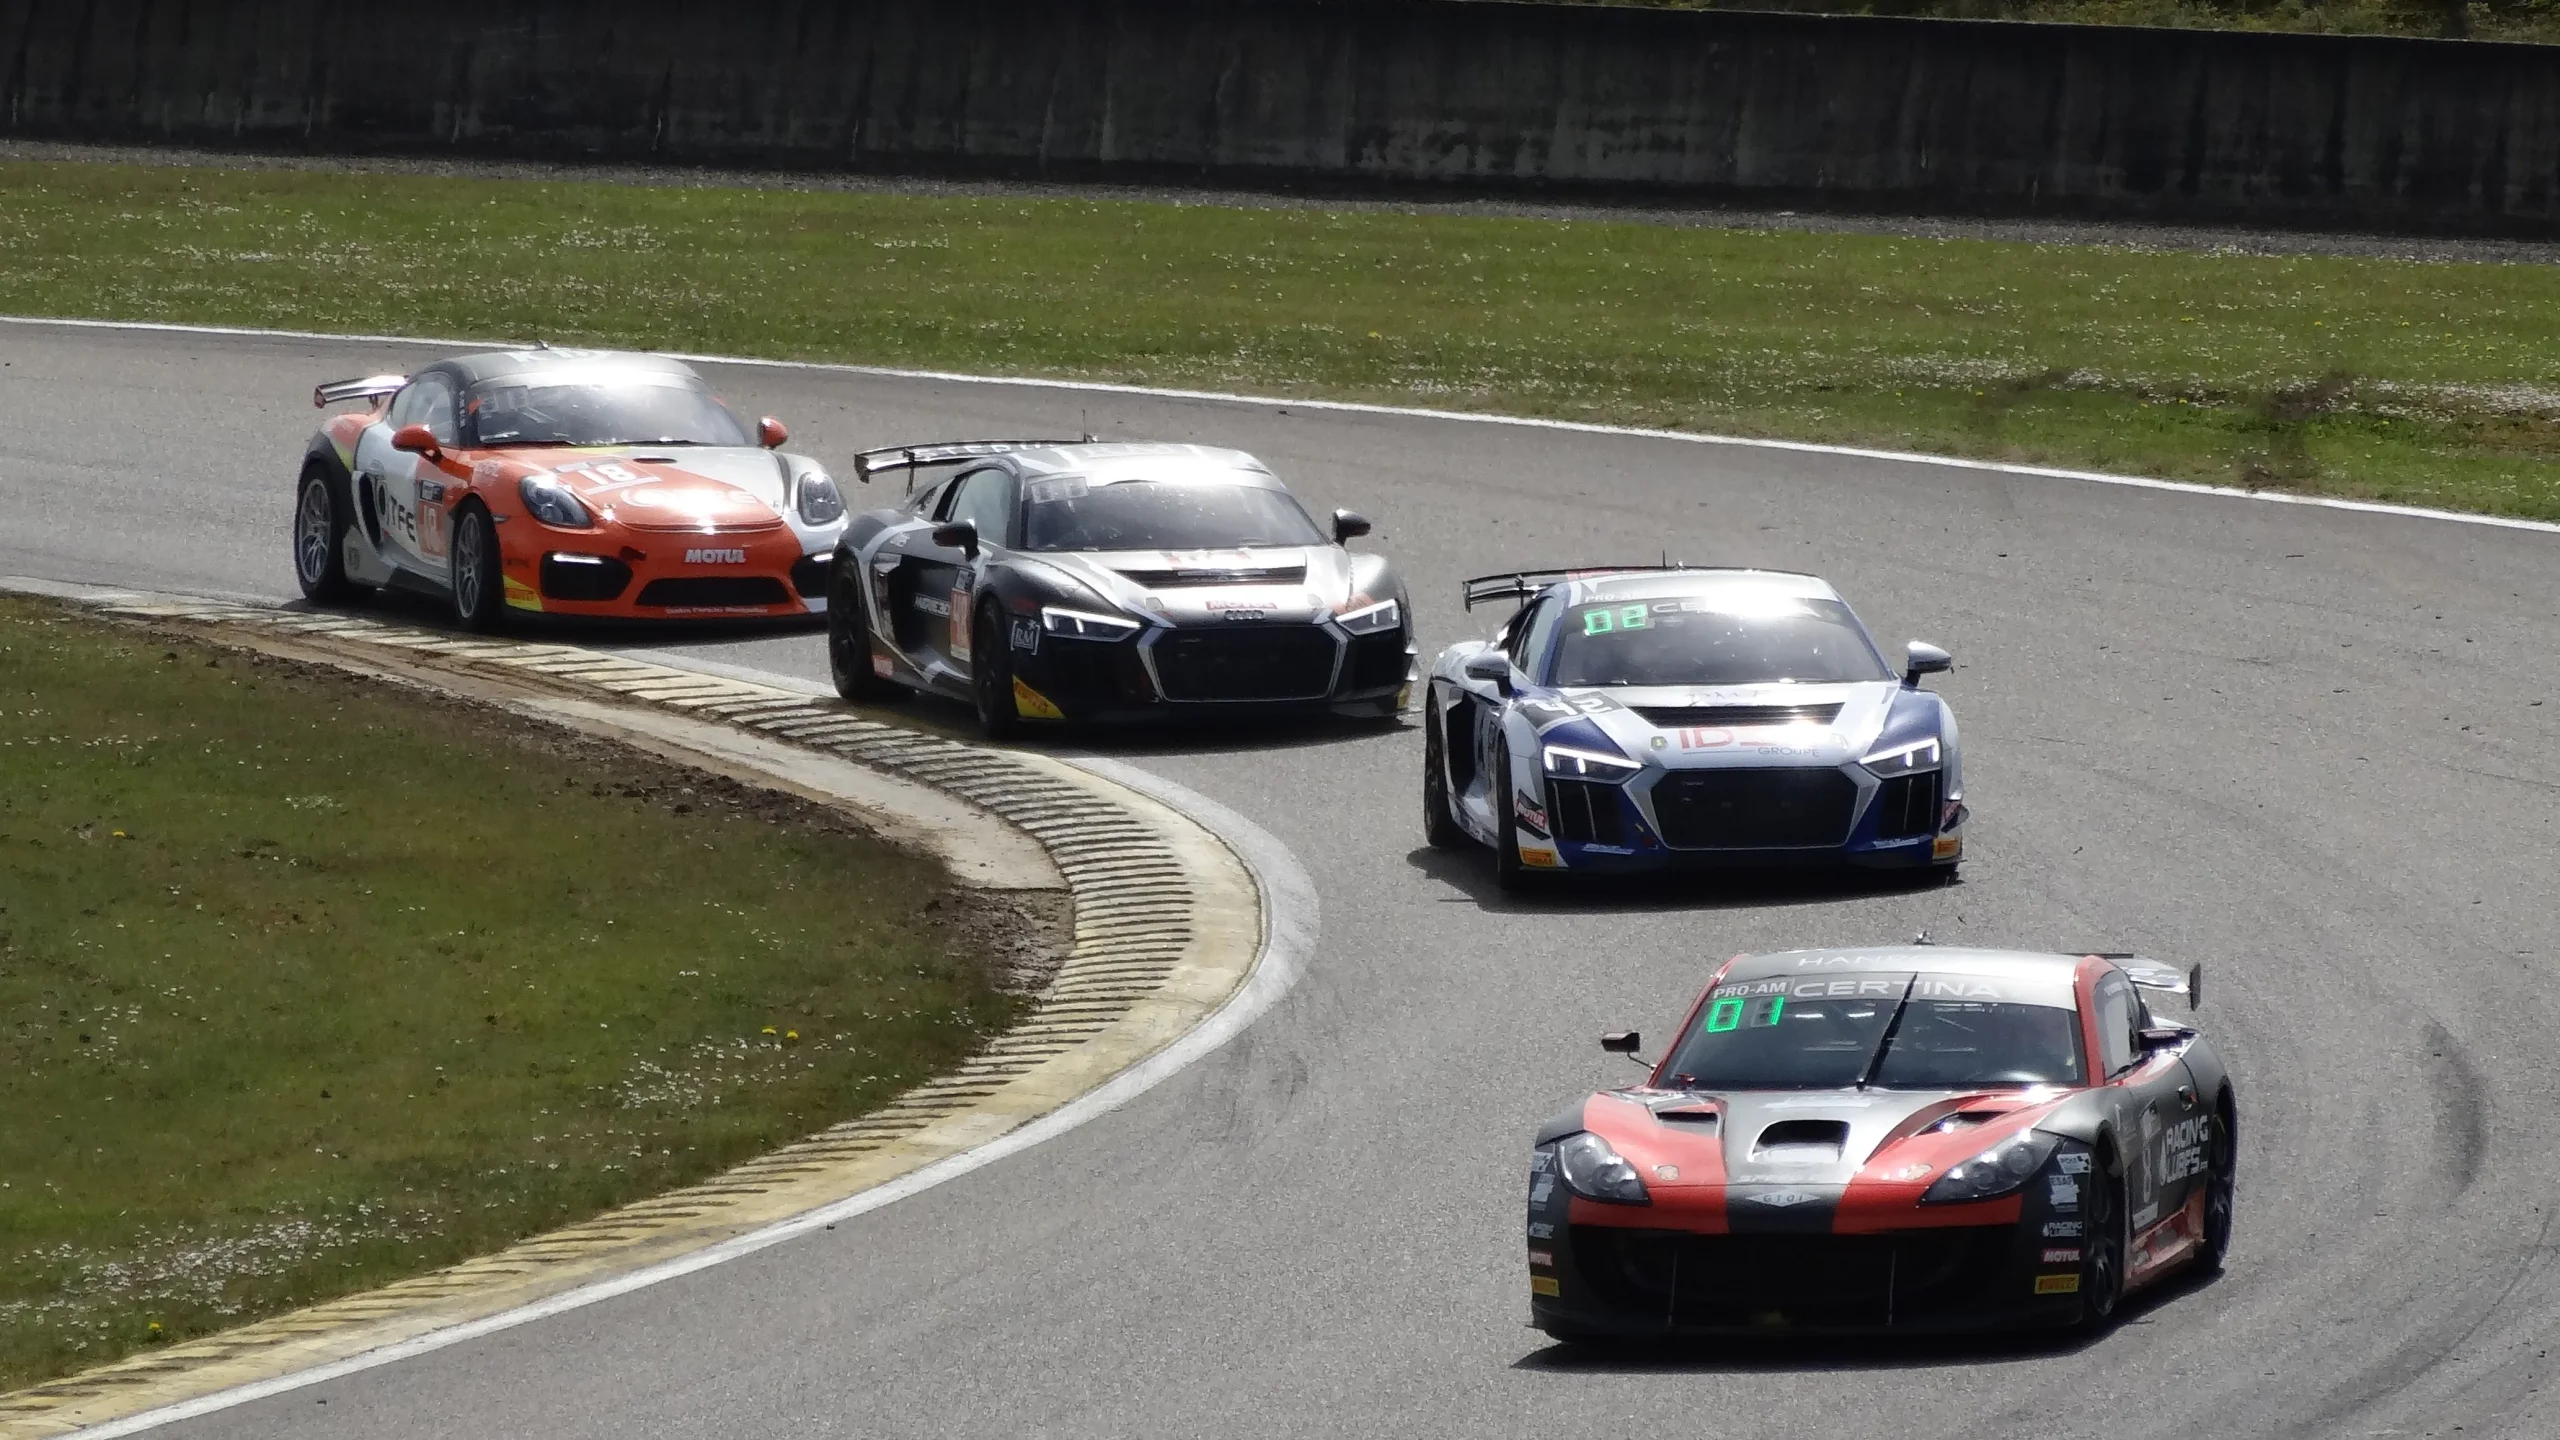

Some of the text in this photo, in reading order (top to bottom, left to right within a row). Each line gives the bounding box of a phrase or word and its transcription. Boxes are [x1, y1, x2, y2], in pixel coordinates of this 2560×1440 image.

[577, 464, 636, 484] 18
[684, 548, 746, 564] MOTUL
[1583, 603, 1648, 636] 02
[1714, 982, 1787, 998] PRO-AM
[1793, 980, 2001, 998] CERTINA
[1707, 996, 1785, 1033] 01
[2166, 1114, 2209, 1154] RACING
[2044, 1251, 2080, 1262] MOTUL
